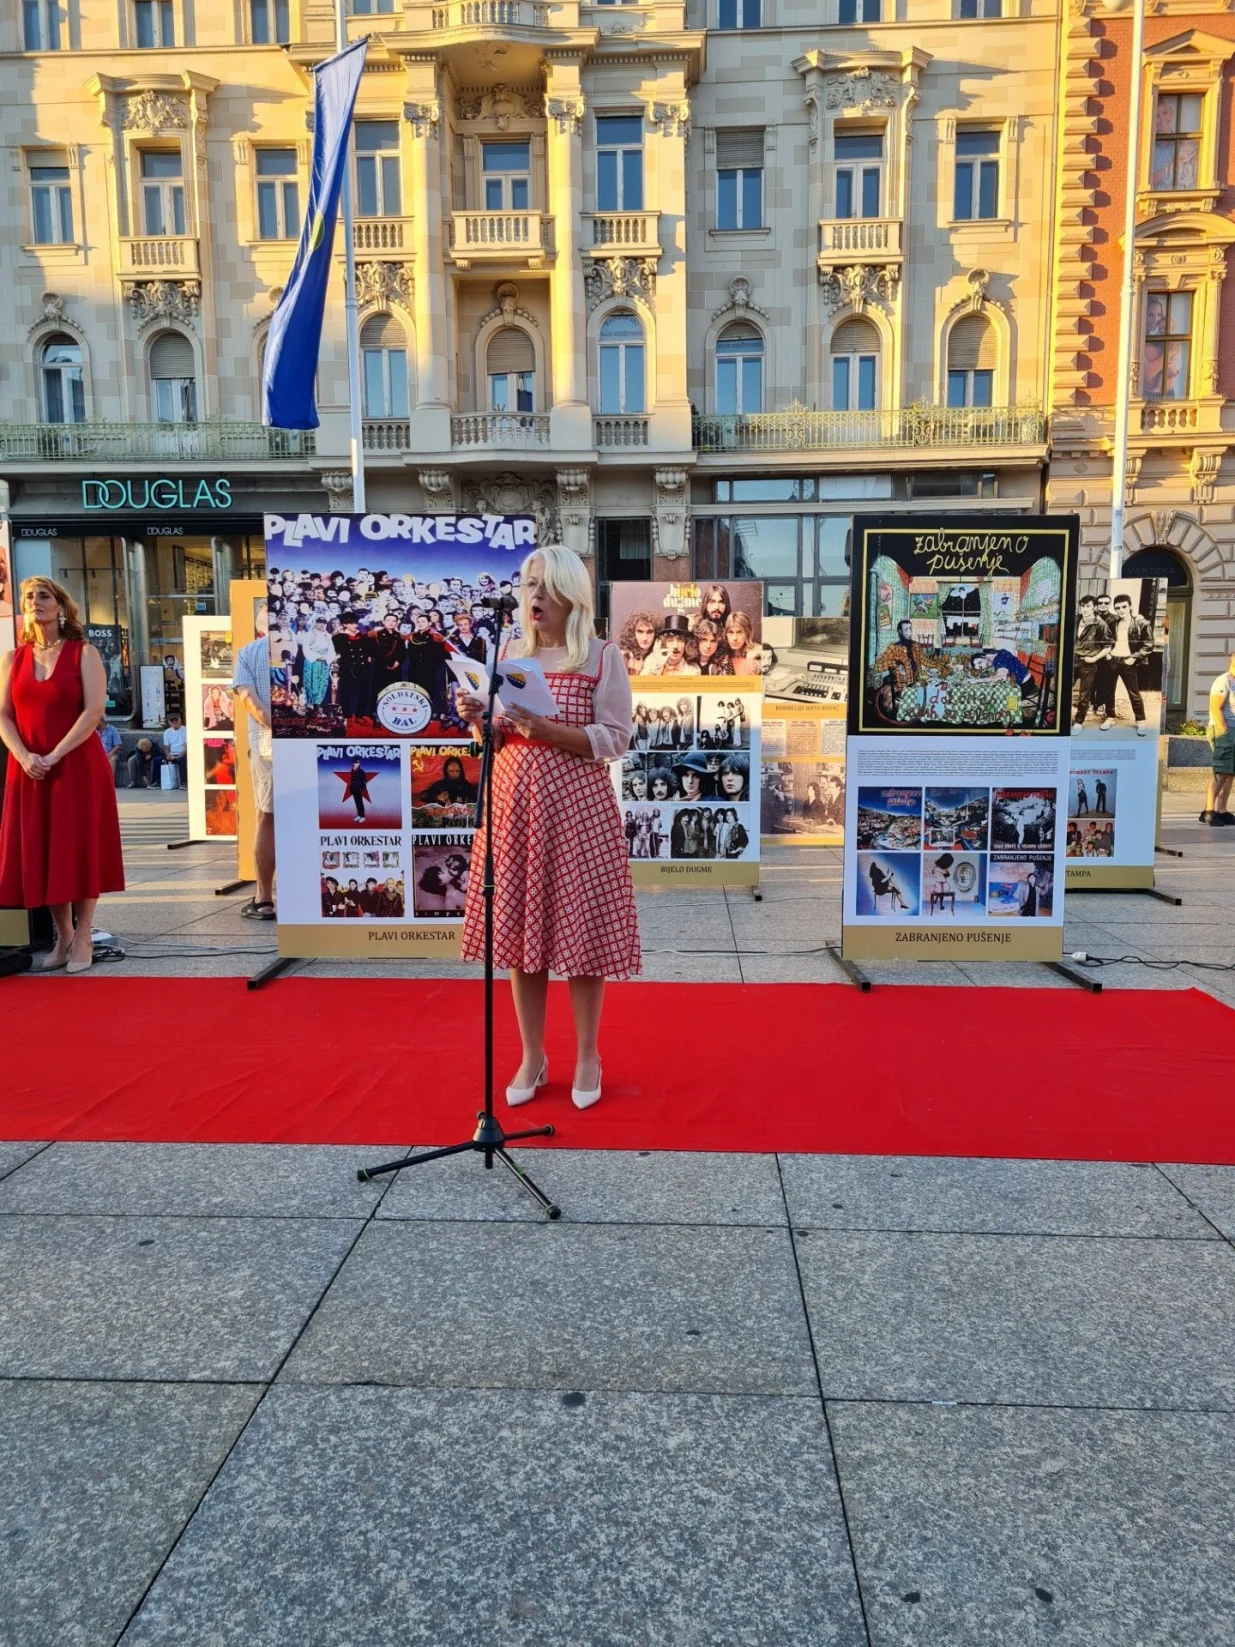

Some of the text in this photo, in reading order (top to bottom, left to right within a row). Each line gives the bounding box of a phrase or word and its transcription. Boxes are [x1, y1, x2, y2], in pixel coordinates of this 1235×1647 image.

[82, 479, 232, 509] DOUGLAS
[21, 528, 57, 537] DOUGLAS
[147, 527, 183, 536] DOUGLAS
[264, 513, 538, 550] PLAVI ORKESTAR
[913, 527, 1029, 555] zabranjeno
[926, 551, 1010, 579] pušenje
[88, 629, 113, 638] BOSS
[382, 691, 429, 709] SOLDATSKI
[392, 717, 417, 727] BAL
[317, 745, 401, 761] PLAVI ORKESTAR
[410, 745, 436, 758] PLAVI
[320, 835, 402, 847] PLAVI ORKESTAR
[412, 834, 472, 846] PLAVI ORKE
[660, 865, 713, 875] BIJELO DUGME
[368, 931, 456, 941] PLAVI ORKESTAR
[895, 931, 1012, 944] ZABRANJENO PUŠENJE
